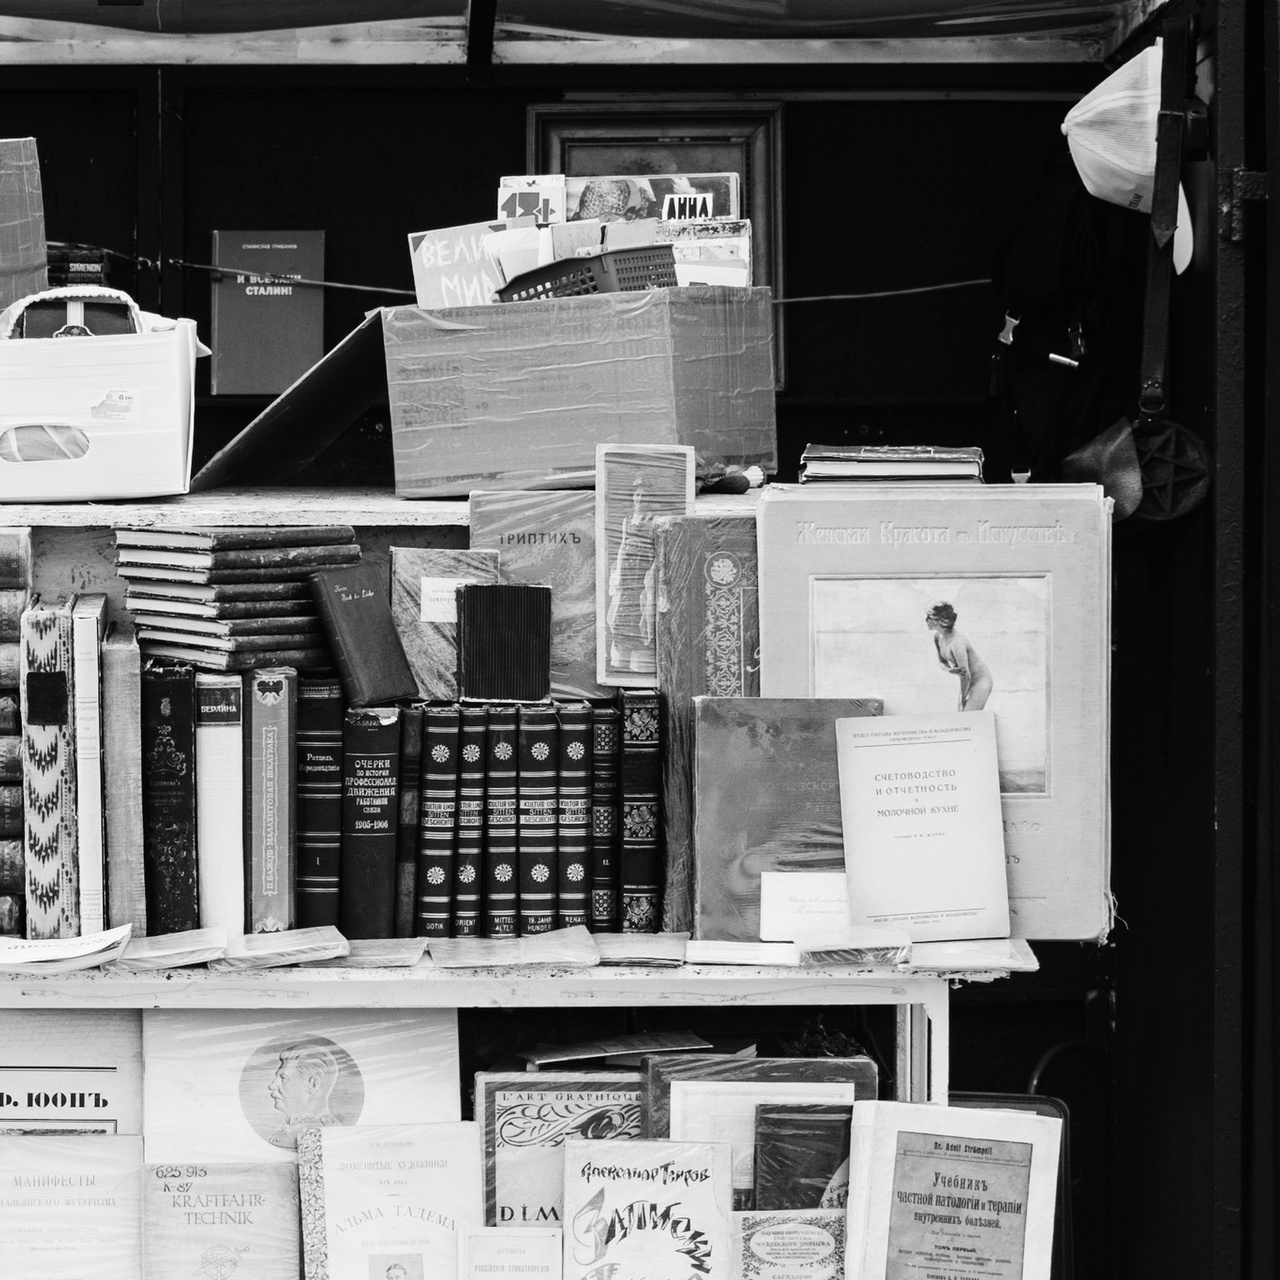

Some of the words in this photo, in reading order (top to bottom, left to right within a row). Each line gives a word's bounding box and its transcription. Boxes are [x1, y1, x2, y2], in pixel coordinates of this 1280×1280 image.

[237, 275, 245, 284] И
[245, 286, 293, 296] СТАЛИН!
[499, 531, 582, 545] ТРИПТИХЪ
[796, 520, 870, 545] Женская
[879, 520, 950, 550] Красота
[201, 705, 237, 713] БЕРЛИНА
[354, 760, 391, 769] ОЧЕРКИ
[874, 770, 956, 782] СЧЕТОВОДСТВО
[346, 787, 396, 797] ДВИЖЕНИЯ
[876, 788, 883, 796] И
[885, 783, 958, 796] ОТЧЕТНОСТЬ
[524, 800, 545, 808] KULTUR
[877, 806, 927, 817] МОЛОЧНОЙ
[930, 805, 959, 814] КУХНЕ
[354, 820, 389, 829] 1905-1906
[503, 1093, 547, 1101] L'ART
[556, 1093, 641, 1101] GRAPHIQUE
[945, 1143, 961, 1151] Adolf
[338, 1161, 393, 1171] ЗНАМЕНИТЫЕ
[397, 1160, 448, 1170] ХУДОЖНИКИ
[13, 1174, 96, 1188] МАНИФЕСТЫ
[932, 1172, 988, 1192] Учебникъ
[64, 1197, 117, 1207] ФУТУРИЗМА
[897, 1190, 933, 1206] частной
[935, 1194, 980, 1211] патологіи
[980, 1203, 986, 1211] и
[987, 1199, 1022, 1215] терапіи
[184, 1211, 254, 1225] TECHNIK
[336, 1207, 384, 1235] АЛЬМА
[393, 1205, 455, 1231] ТАДЕМА
[914, 1211, 962, 1225] внутреннихъ
